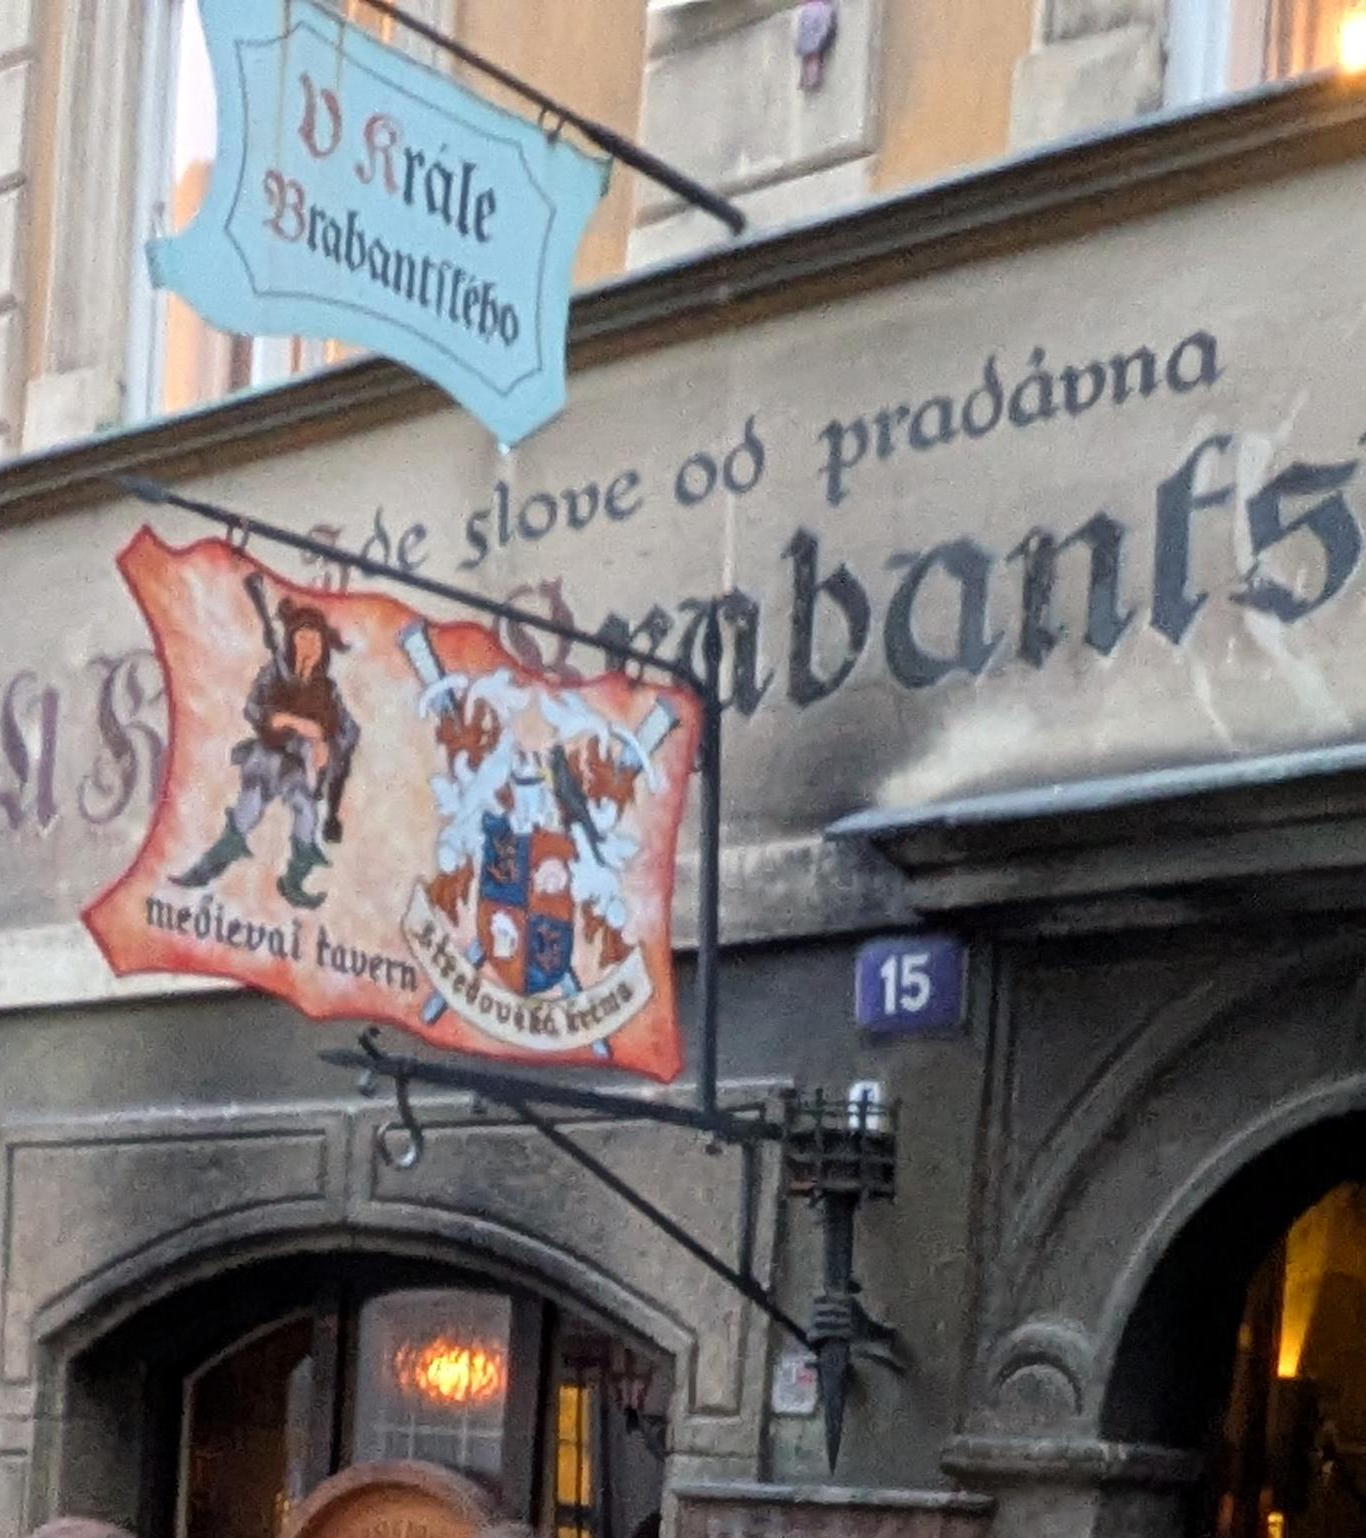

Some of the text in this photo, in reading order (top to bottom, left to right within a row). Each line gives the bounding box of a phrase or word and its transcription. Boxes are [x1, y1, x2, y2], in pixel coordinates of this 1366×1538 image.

[352, 111, 499, 244] Krále
[457, 467, 643, 573] slove
[674, 415, 766, 506] od
[819, 329, 1224, 508] pradávna
[144, 894, 418, 992] medieval tavern
[880, 953, 931, 1016] 15
